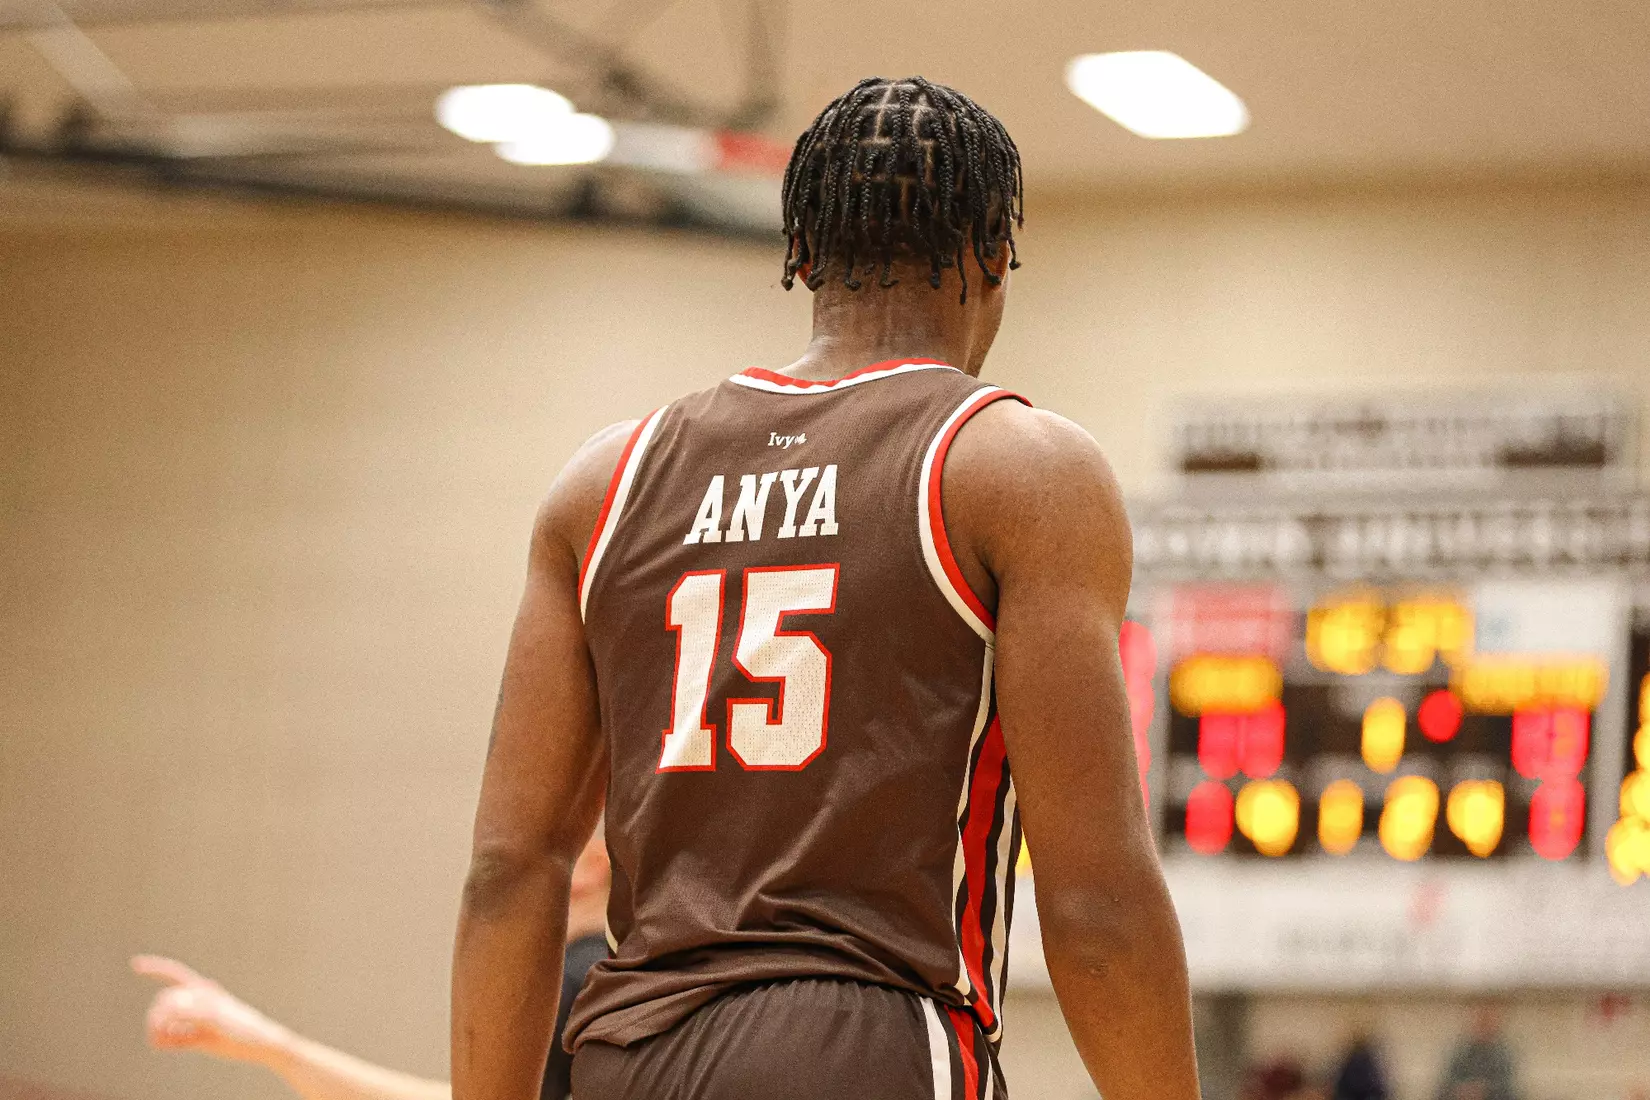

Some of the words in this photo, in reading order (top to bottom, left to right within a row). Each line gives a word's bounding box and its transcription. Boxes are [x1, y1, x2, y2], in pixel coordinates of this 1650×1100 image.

[768, 432, 795, 449] Ivy
[683, 464, 839, 545] ANYA
[655, 563, 840, 774] 15
